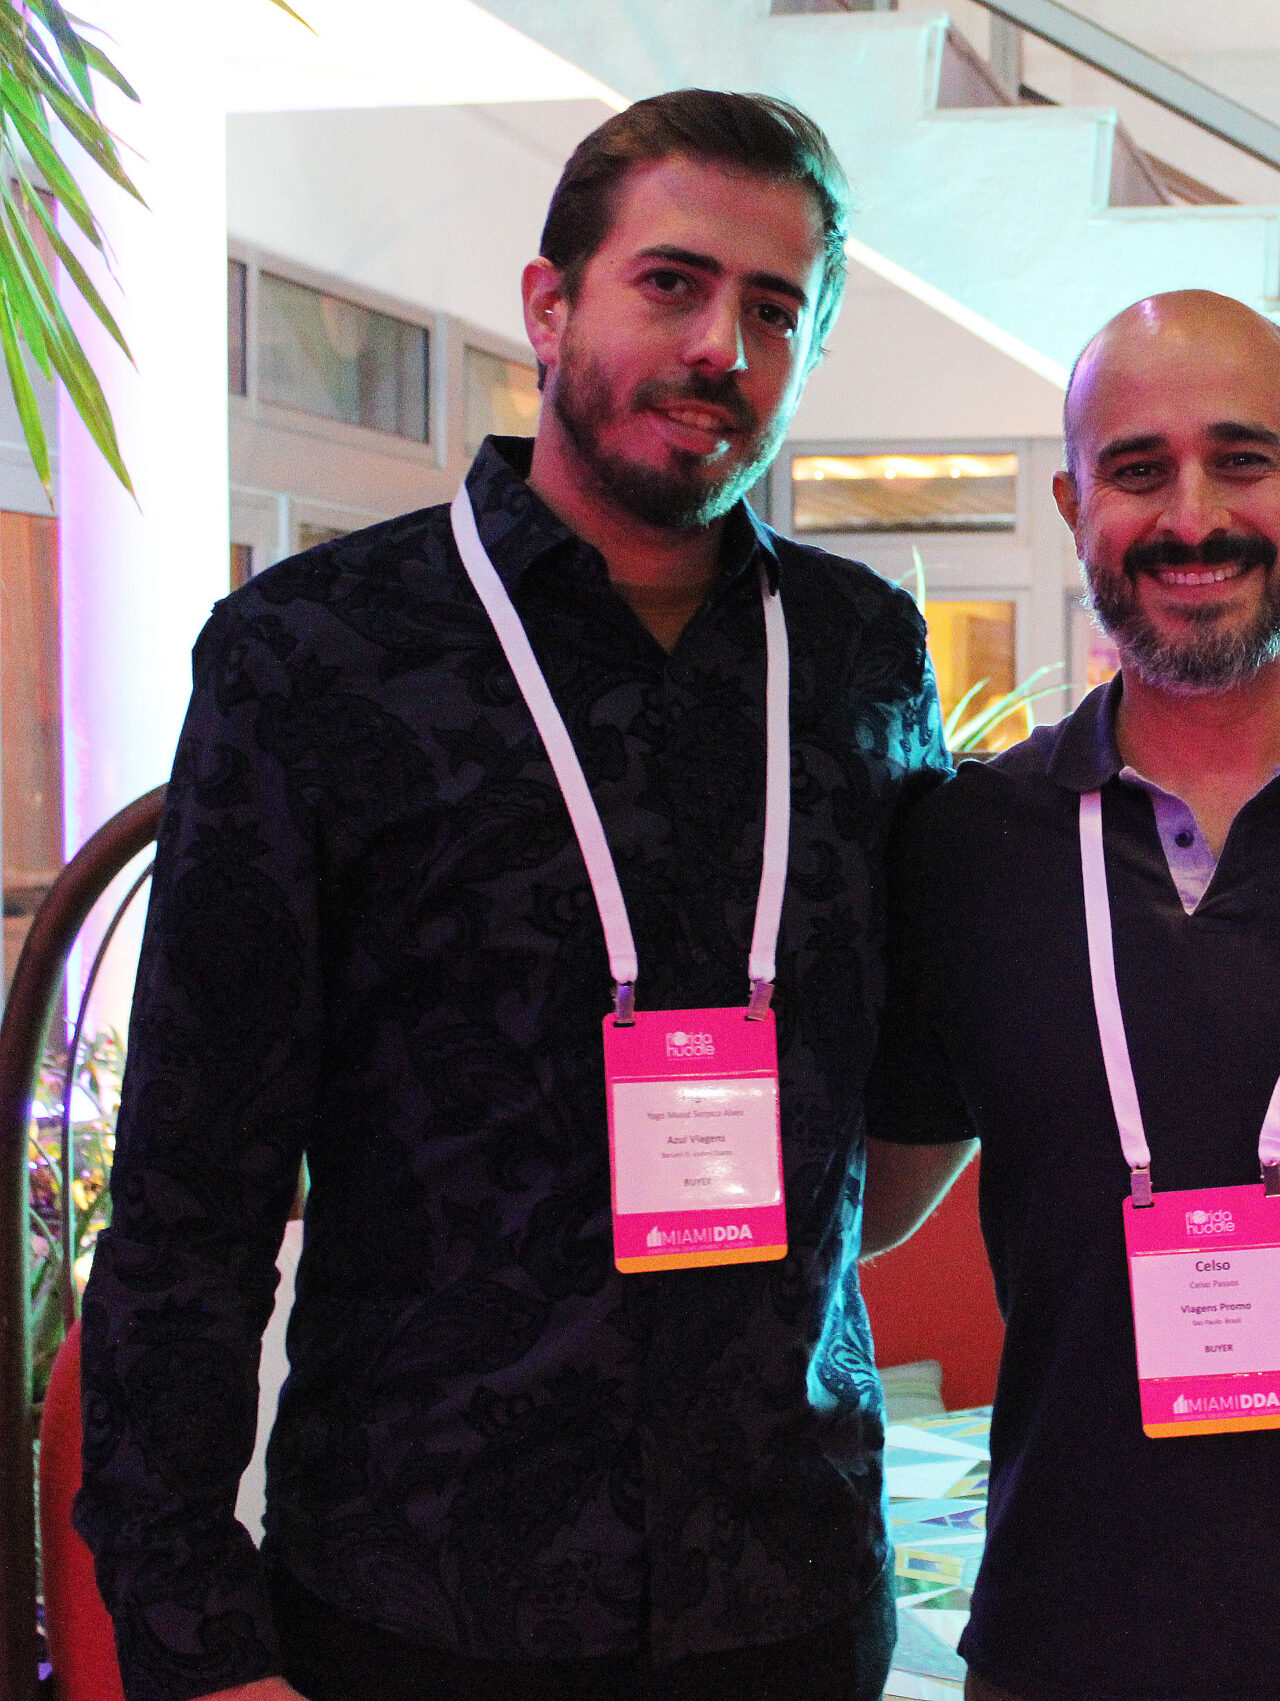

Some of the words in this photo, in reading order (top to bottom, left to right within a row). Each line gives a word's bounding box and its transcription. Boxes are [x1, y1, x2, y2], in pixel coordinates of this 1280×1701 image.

[667, 1043, 715, 1057] huddle
[1185, 1210, 1233, 1226] florida
[1187, 1220, 1236, 1235] huddle
[1195, 1259, 1231, 1272] Celso
[1181, 1305, 1218, 1315] Viagens
[1219, 1303, 1252, 1311] Promo
[1204, 1344, 1234, 1353] BUYER
[1187, 1391, 1280, 1413] MIAMIDDA
